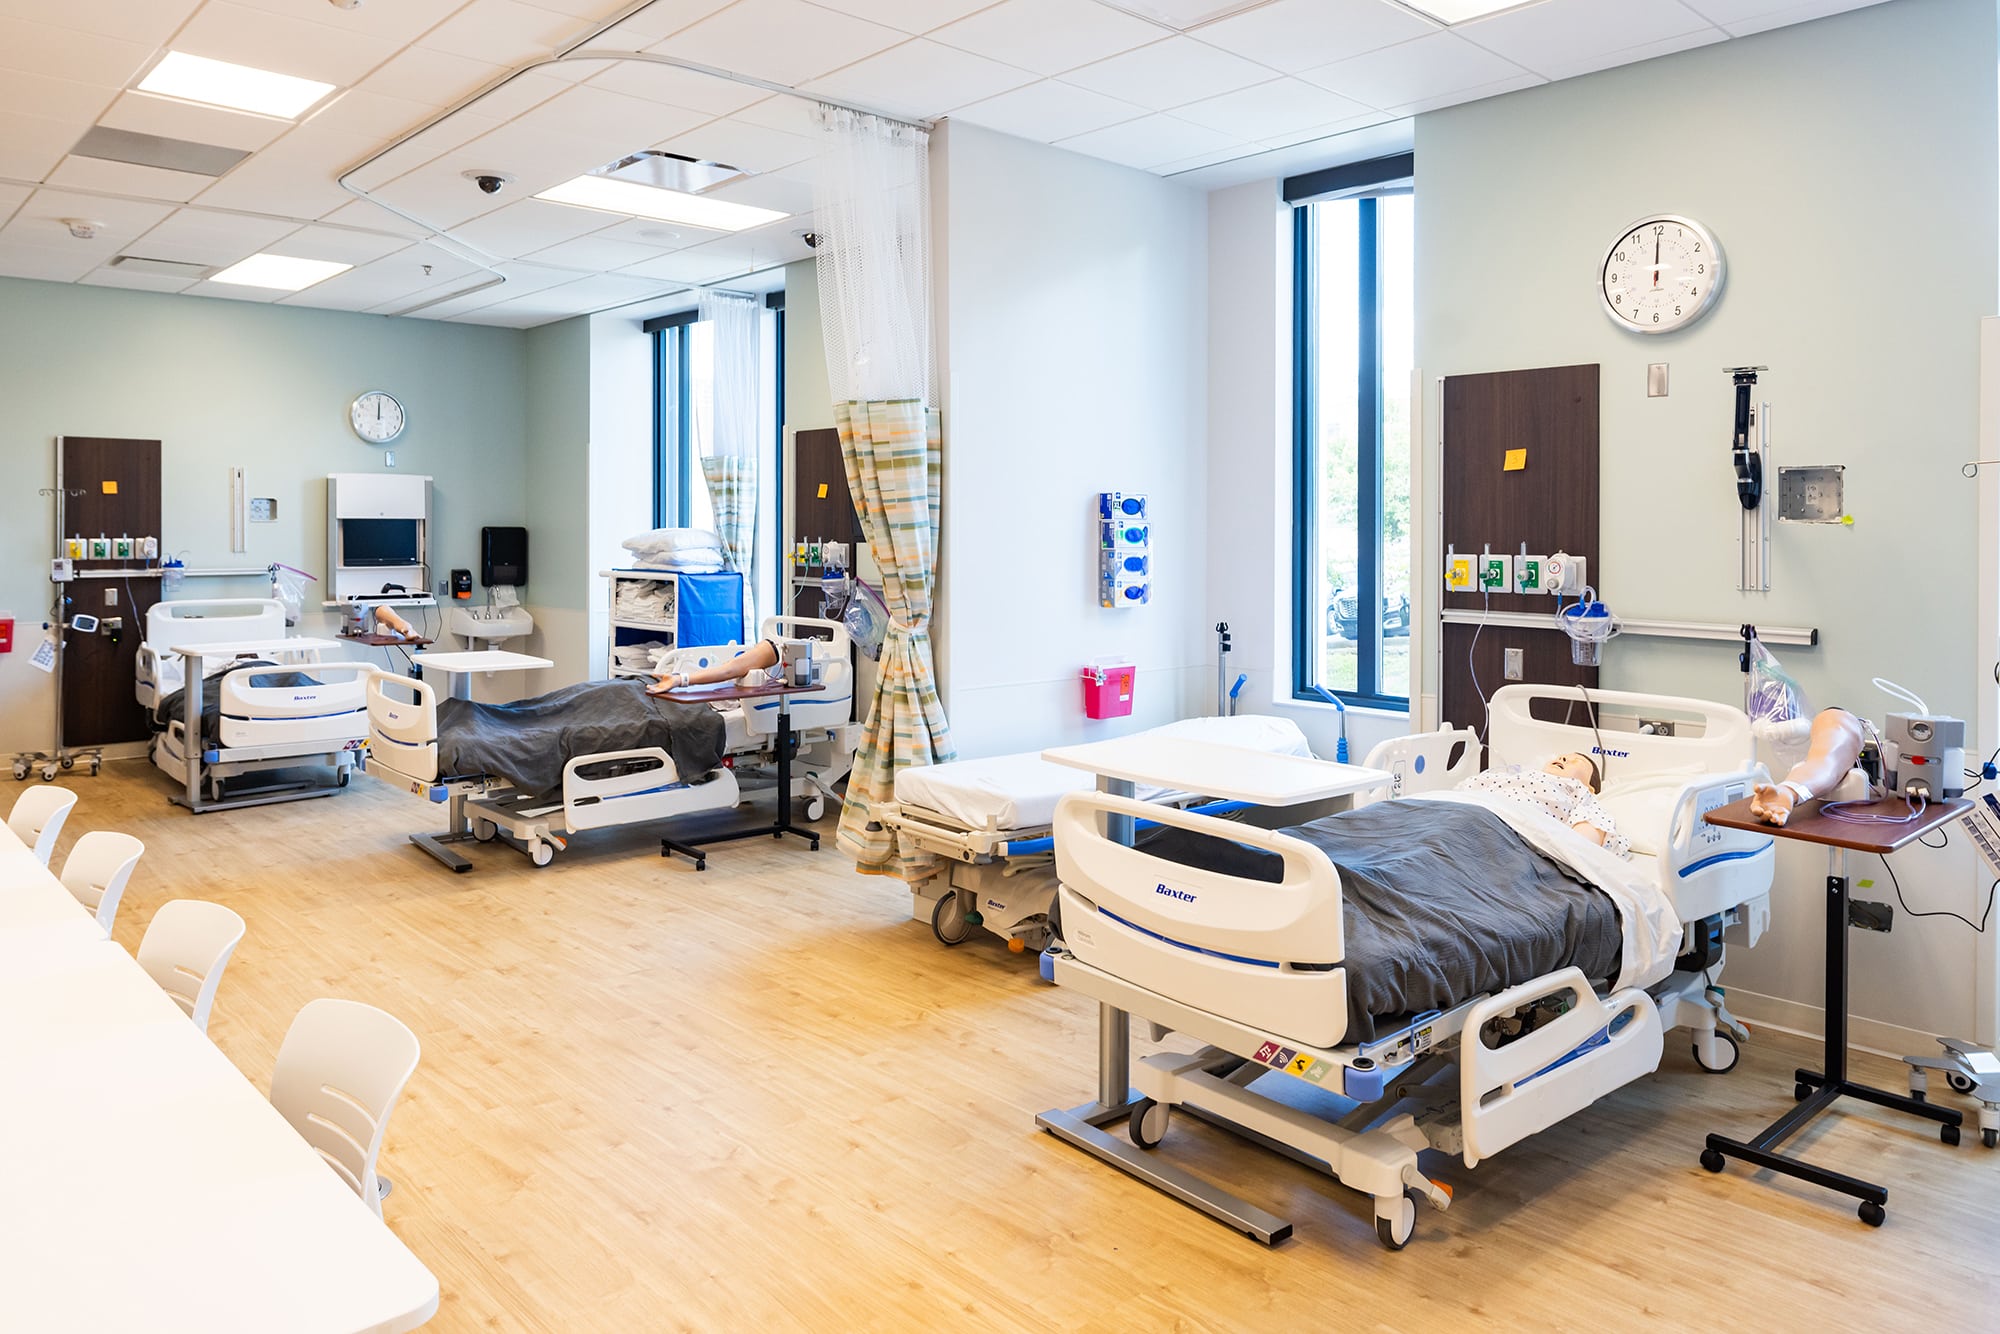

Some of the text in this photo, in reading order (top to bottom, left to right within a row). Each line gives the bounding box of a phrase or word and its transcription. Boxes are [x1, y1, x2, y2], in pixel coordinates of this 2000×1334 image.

[1653, 225, 1664, 236] 12
[1677, 228, 1682, 238] 1
[1631, 234, 1641, 244] 11
[1694, 242, 1701, 253] 2
[1614, 251, 1626, 262] 10
[1697, 263, 1704, 274] 3
[1611, 273, 1618, 283] 9
[1691, 286, 1697, 297] 4
[1615, 294, 1622, 305] 8
[1633, 309, 1639, 319] 7
[1674, 305, 1681, 316] 5
[1652, 312, 1660, 323] 6
[1156, 883, 1197, 903] Baxter
